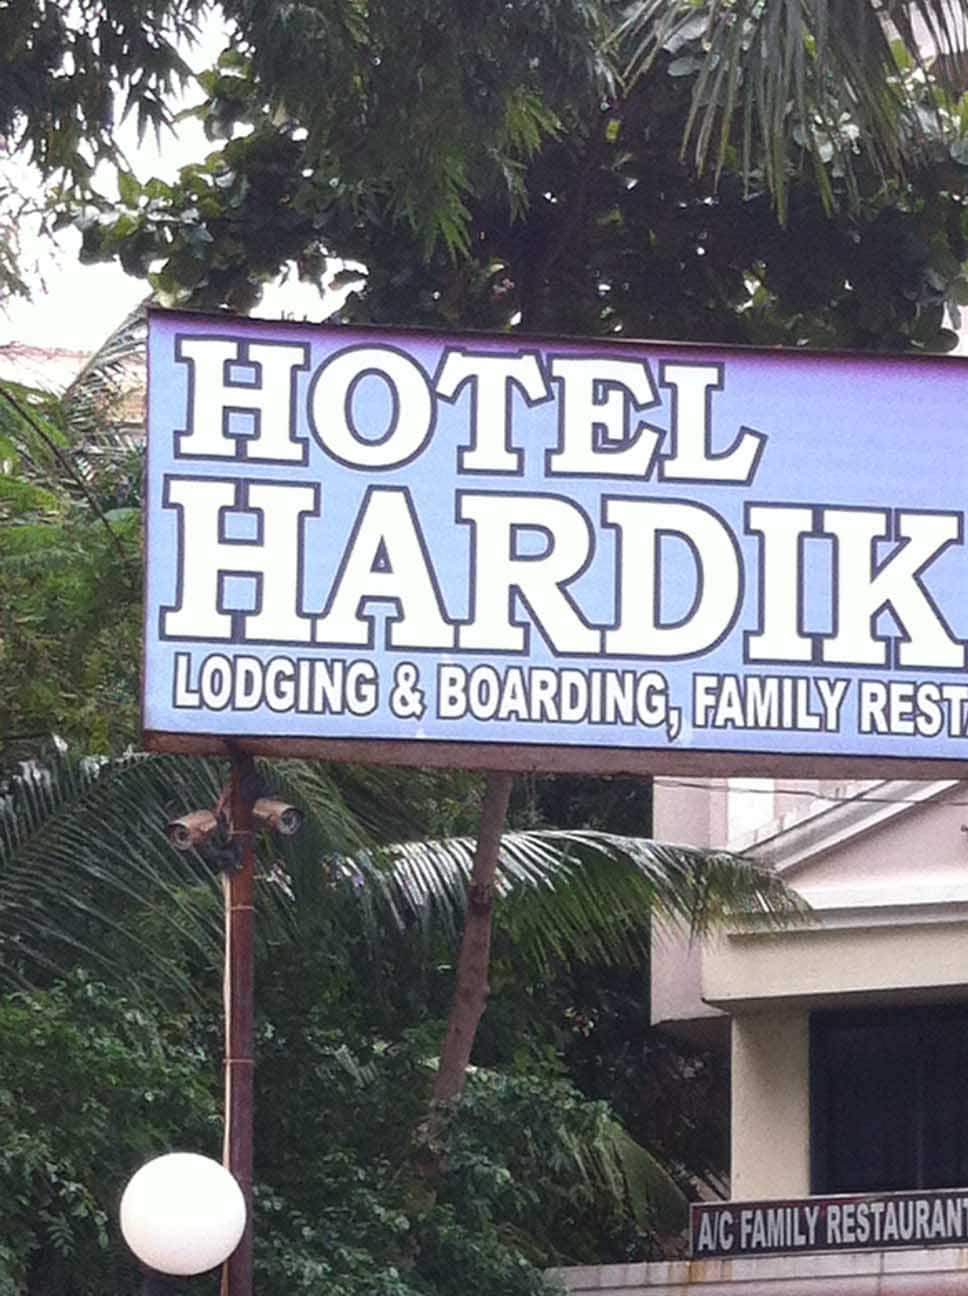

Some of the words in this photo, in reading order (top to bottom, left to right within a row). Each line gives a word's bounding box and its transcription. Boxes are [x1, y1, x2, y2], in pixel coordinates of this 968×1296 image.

[173, 333, 768, 486] HOTEL
[173, 651, 378, 719] LODGING
[389, 660, 426, 720] &
[437, 664, 682, 741] BOARDING,
[692, 671, 850, 733] FAMILY
[698, 1211, 734, 1251] A/C
[740, 1206, 820, 1249] FAMILY
